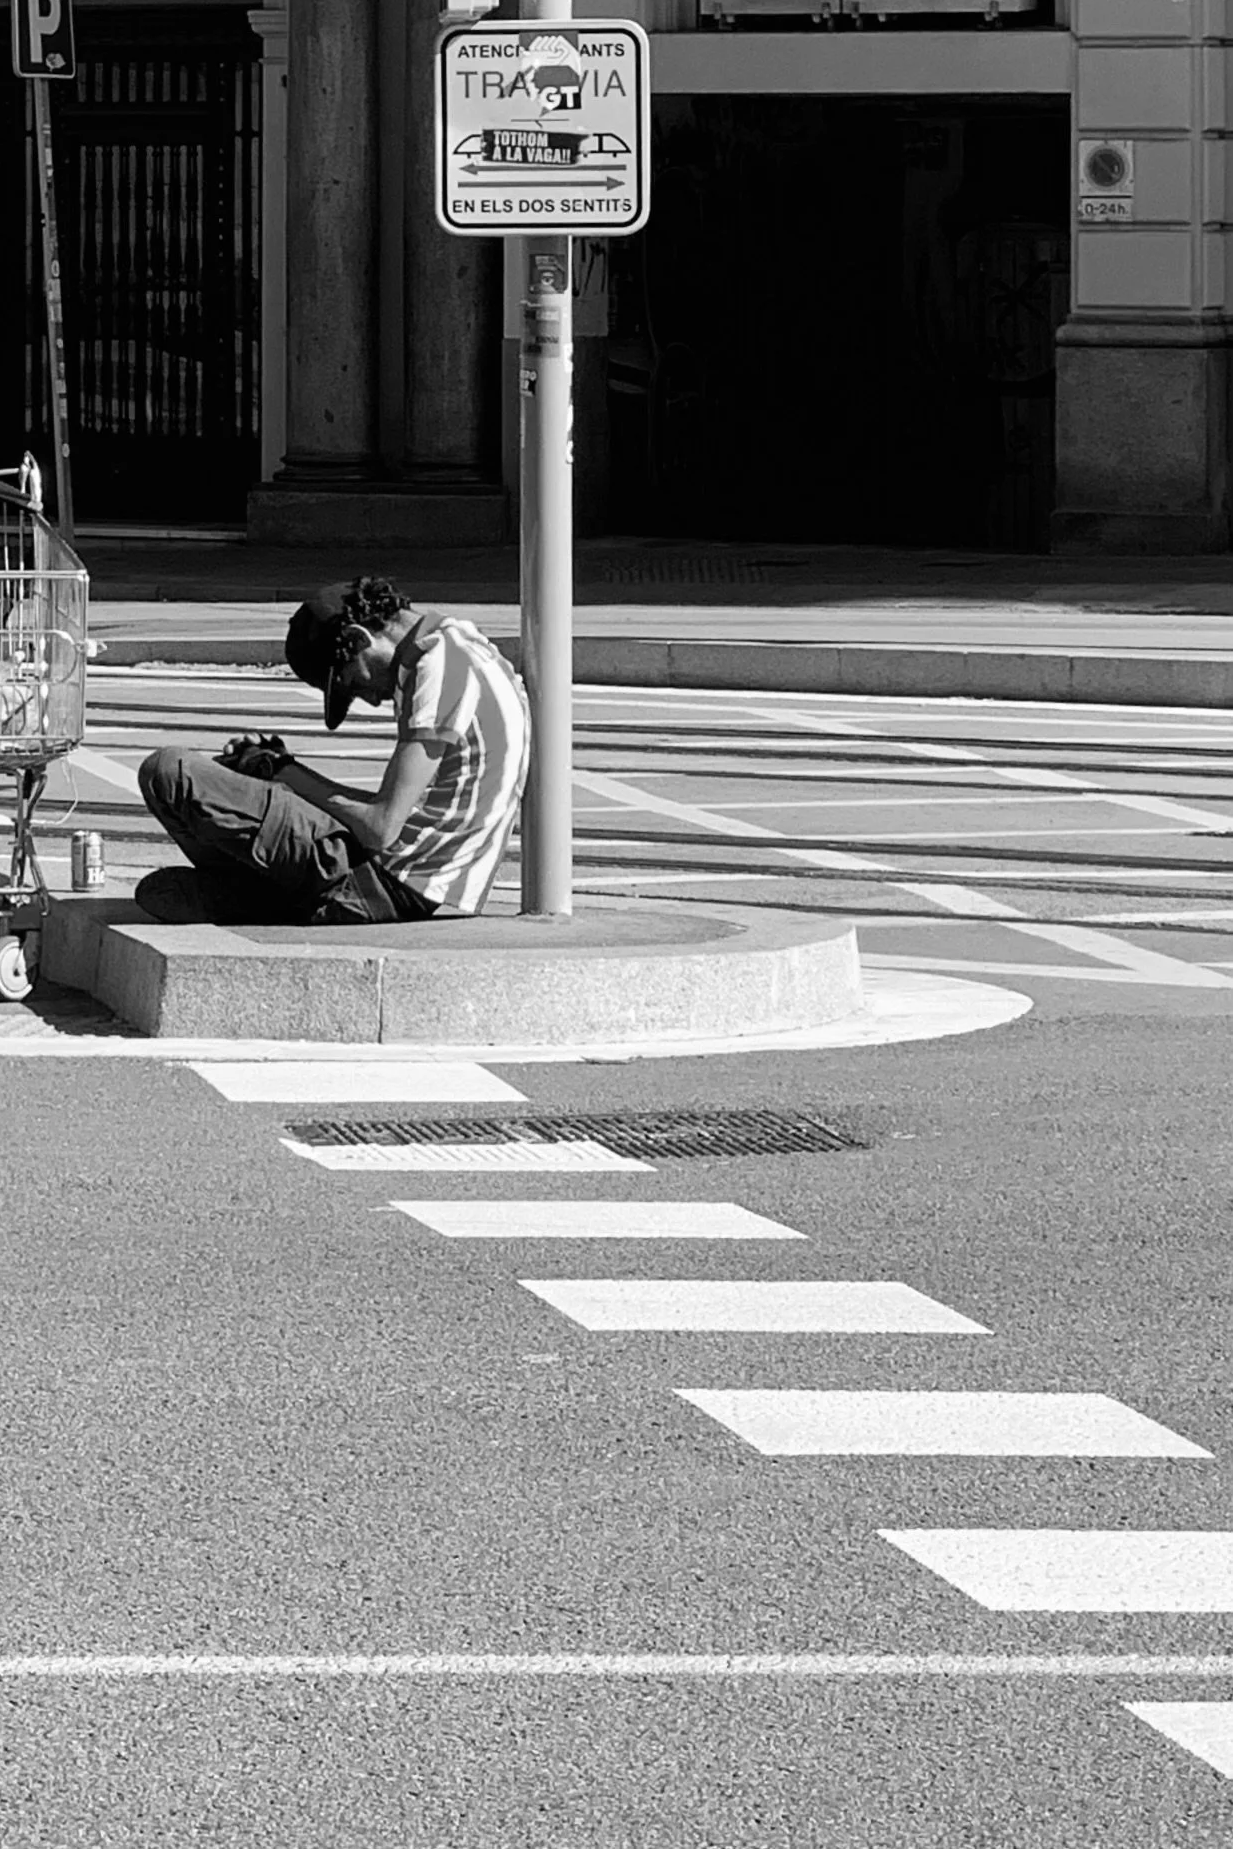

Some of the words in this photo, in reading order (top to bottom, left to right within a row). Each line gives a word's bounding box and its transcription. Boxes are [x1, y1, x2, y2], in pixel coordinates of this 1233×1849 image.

[457, 44, 520, 59] ATENCI
[579, 43, 626, 57] ANTS
[538, 85, 580, 110] GT
[492, 131, 549, 147] TOTHOM
[505, 146, 523, 162] LA
[526, 147, 572, 164] VAGA!!
[452, 199, 476, 213] EN
[480, 199, 513, 213] ELS
[518, 199, 555, 213] DOS
[560, 198, 633, 213] SENTITS
